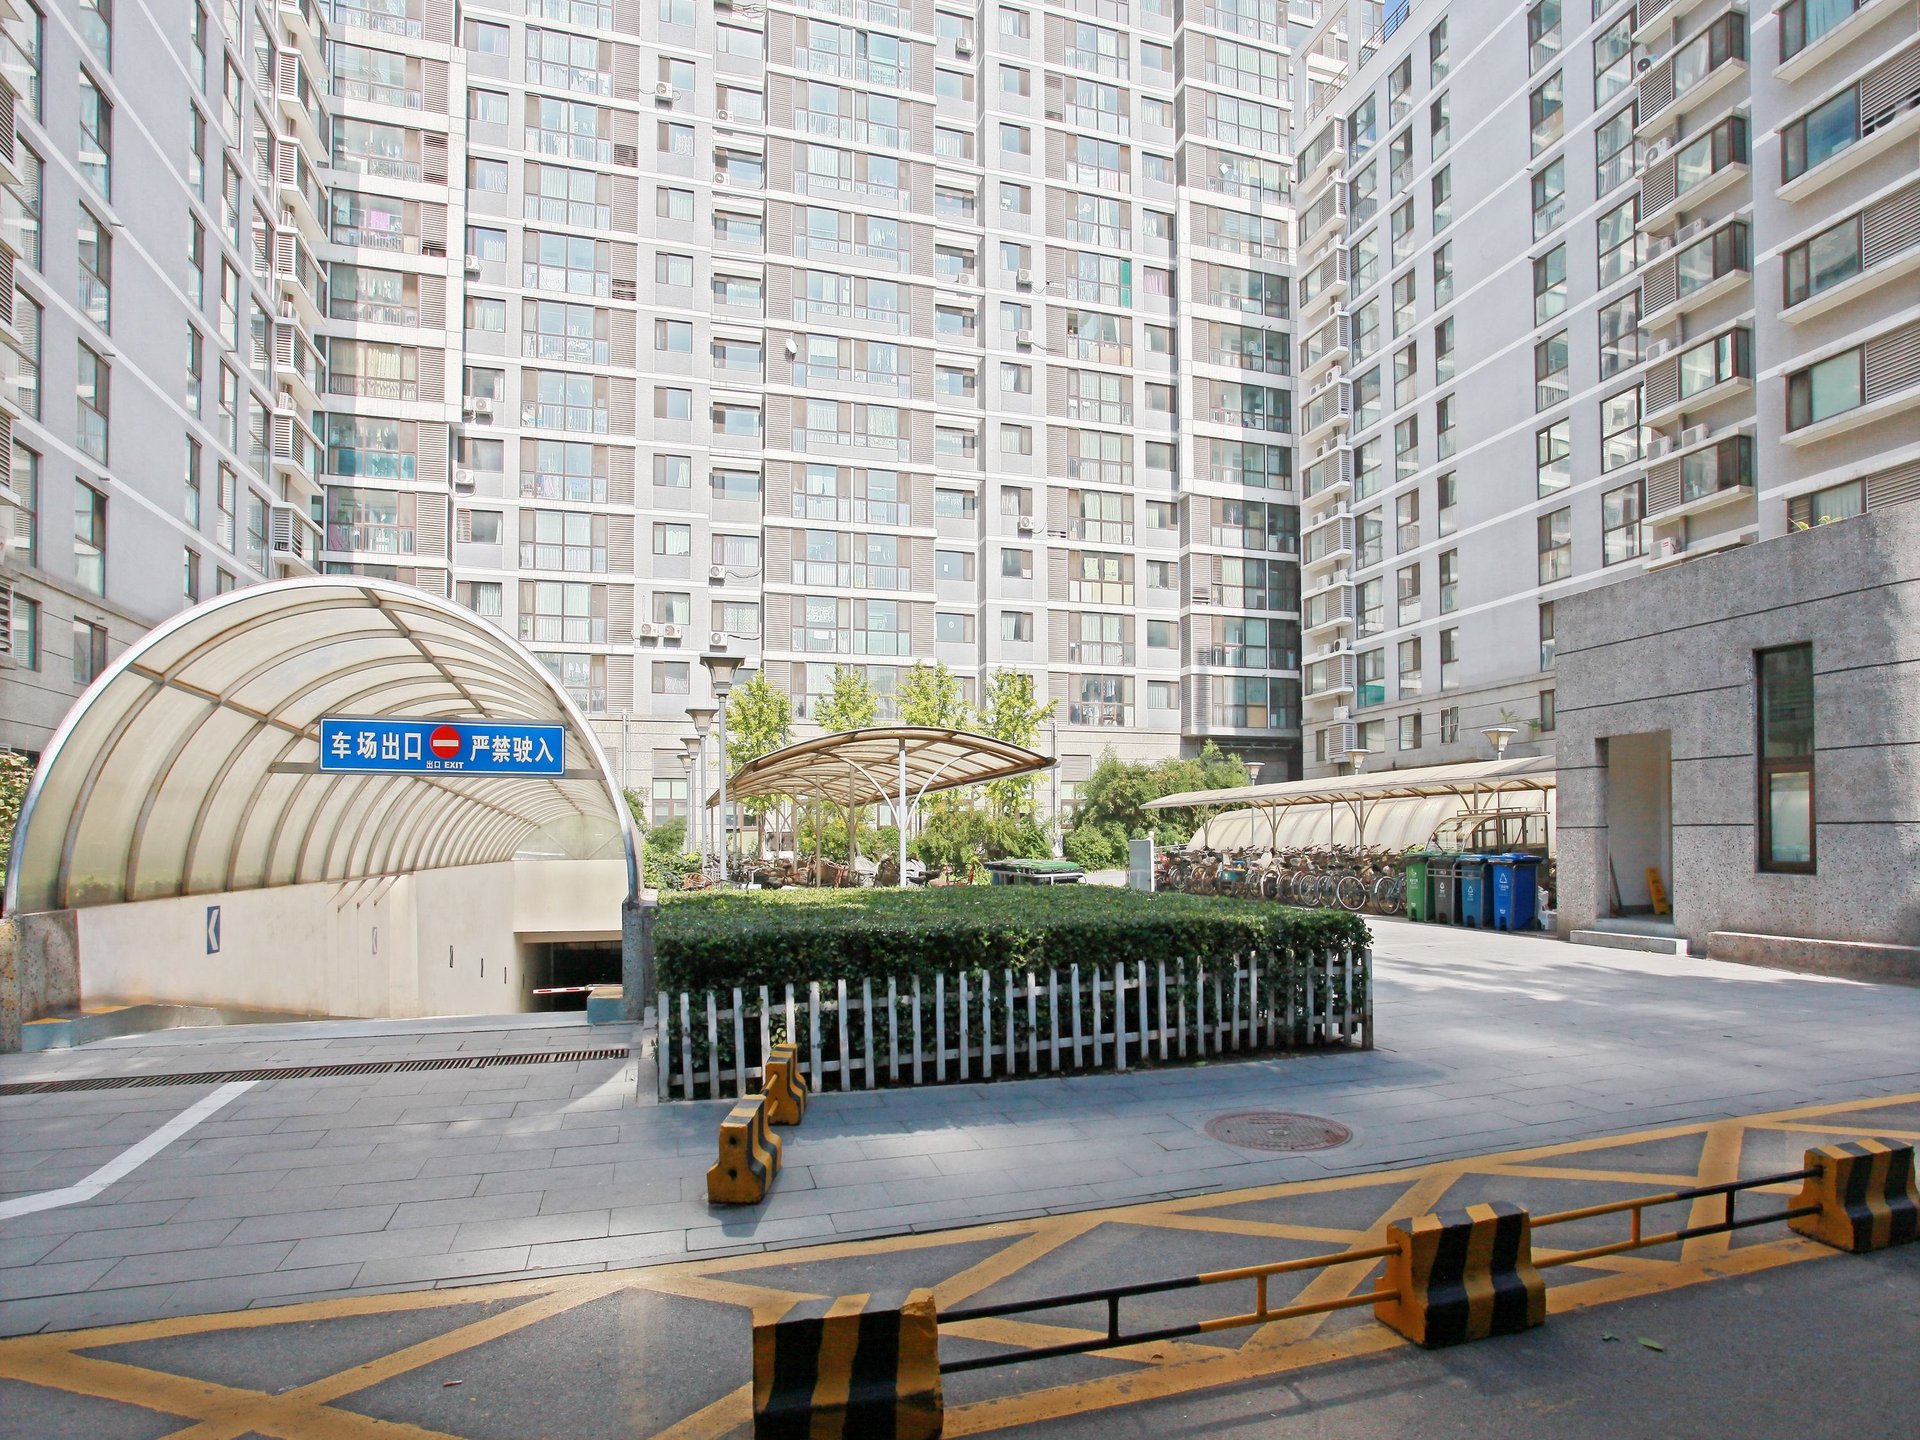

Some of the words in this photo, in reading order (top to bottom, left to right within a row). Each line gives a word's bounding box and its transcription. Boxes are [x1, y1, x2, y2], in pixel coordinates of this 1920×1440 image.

[331, 731, 422, 761] 车场出口
[470, 734, 554, 763] 严禁驶入
[426, 760, 441, 769] 出口
[444, 761, 465, 769] EXIT
